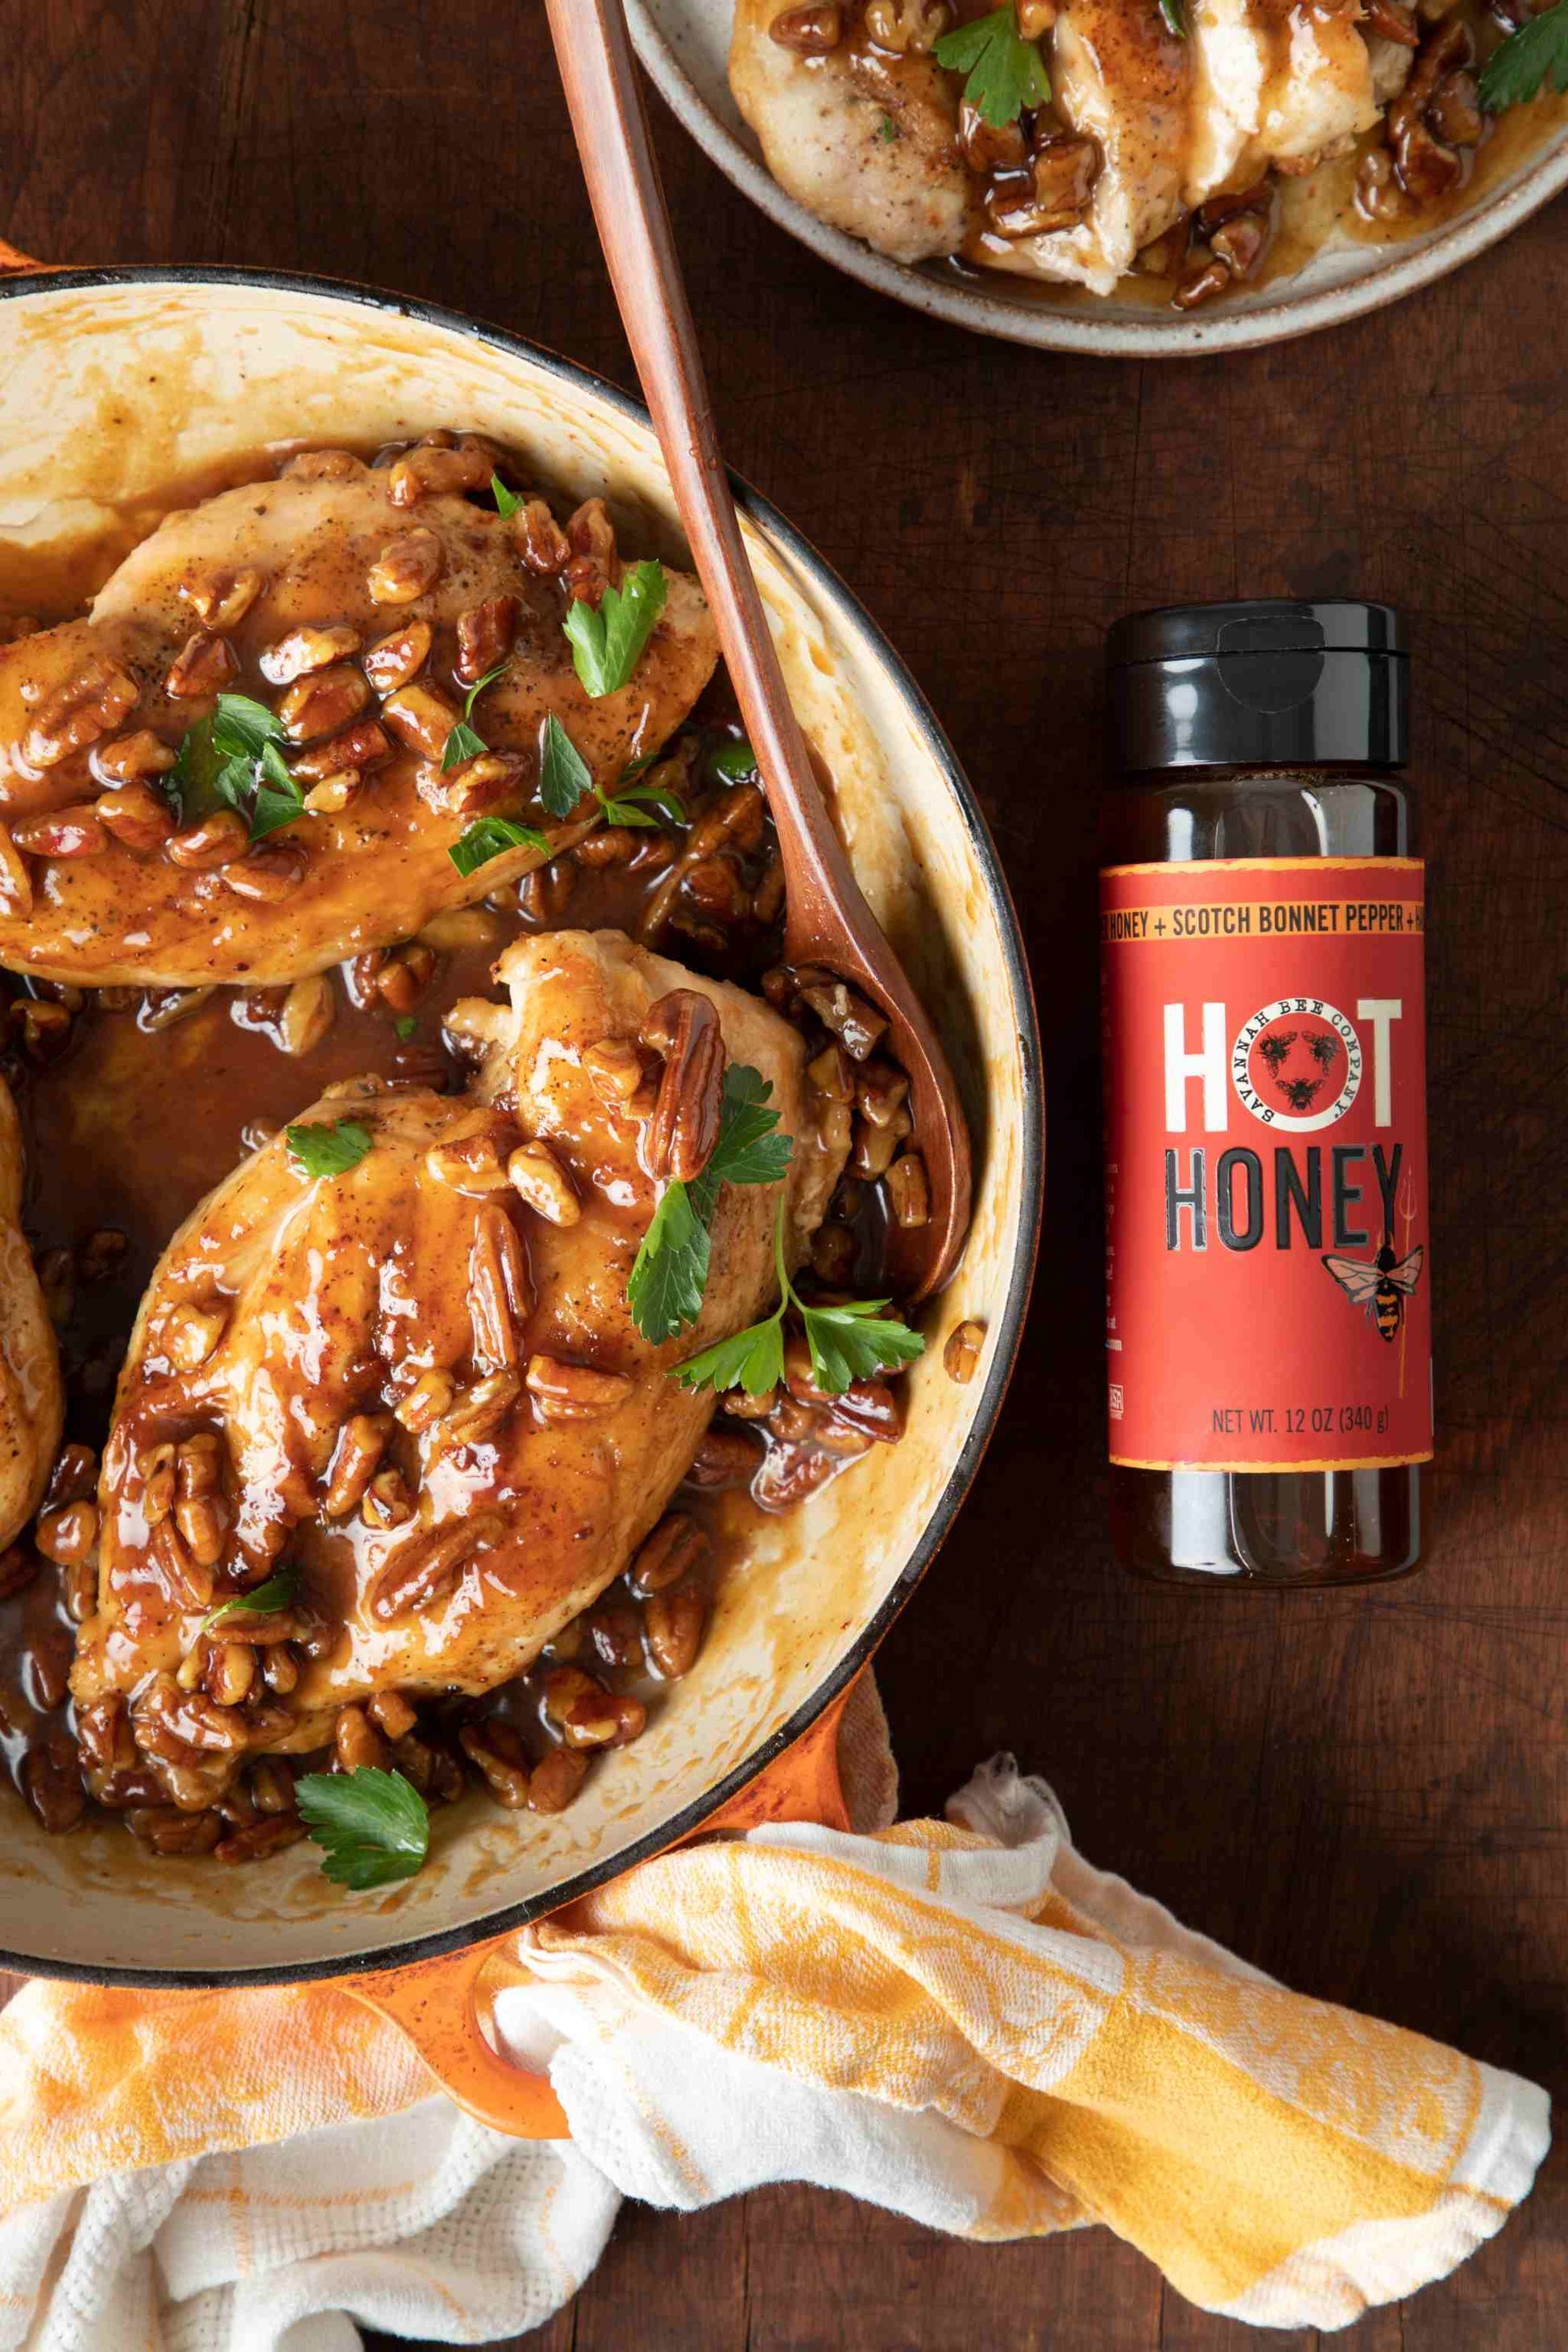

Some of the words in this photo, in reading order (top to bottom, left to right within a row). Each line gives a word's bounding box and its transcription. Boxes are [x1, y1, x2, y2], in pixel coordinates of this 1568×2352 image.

[1110, 911, 1149, 940] HONEY
[1172, 906, 1251, 936] SCOTCH
[1259, 904, 1340, 933] BONNET
[1346, 903, 1404, 931] PEPPER
[1164, 998, 1403, 1133] HOT
[1234, 1013, 1275, 1123] SAVANNAH
[1280, 998, 1324, 1015] BEE
[1164, 1143, 1404, 1253] HONEY
[1212, 1409, 1243, 1433] NET
[1250, 1409, 1278, 1433] WT.
[1285, 1408, 1305, 1433] 12
[1311, 1408, 1334, 1433] OZ
[1339, 1406, 1372, 1433] (340
